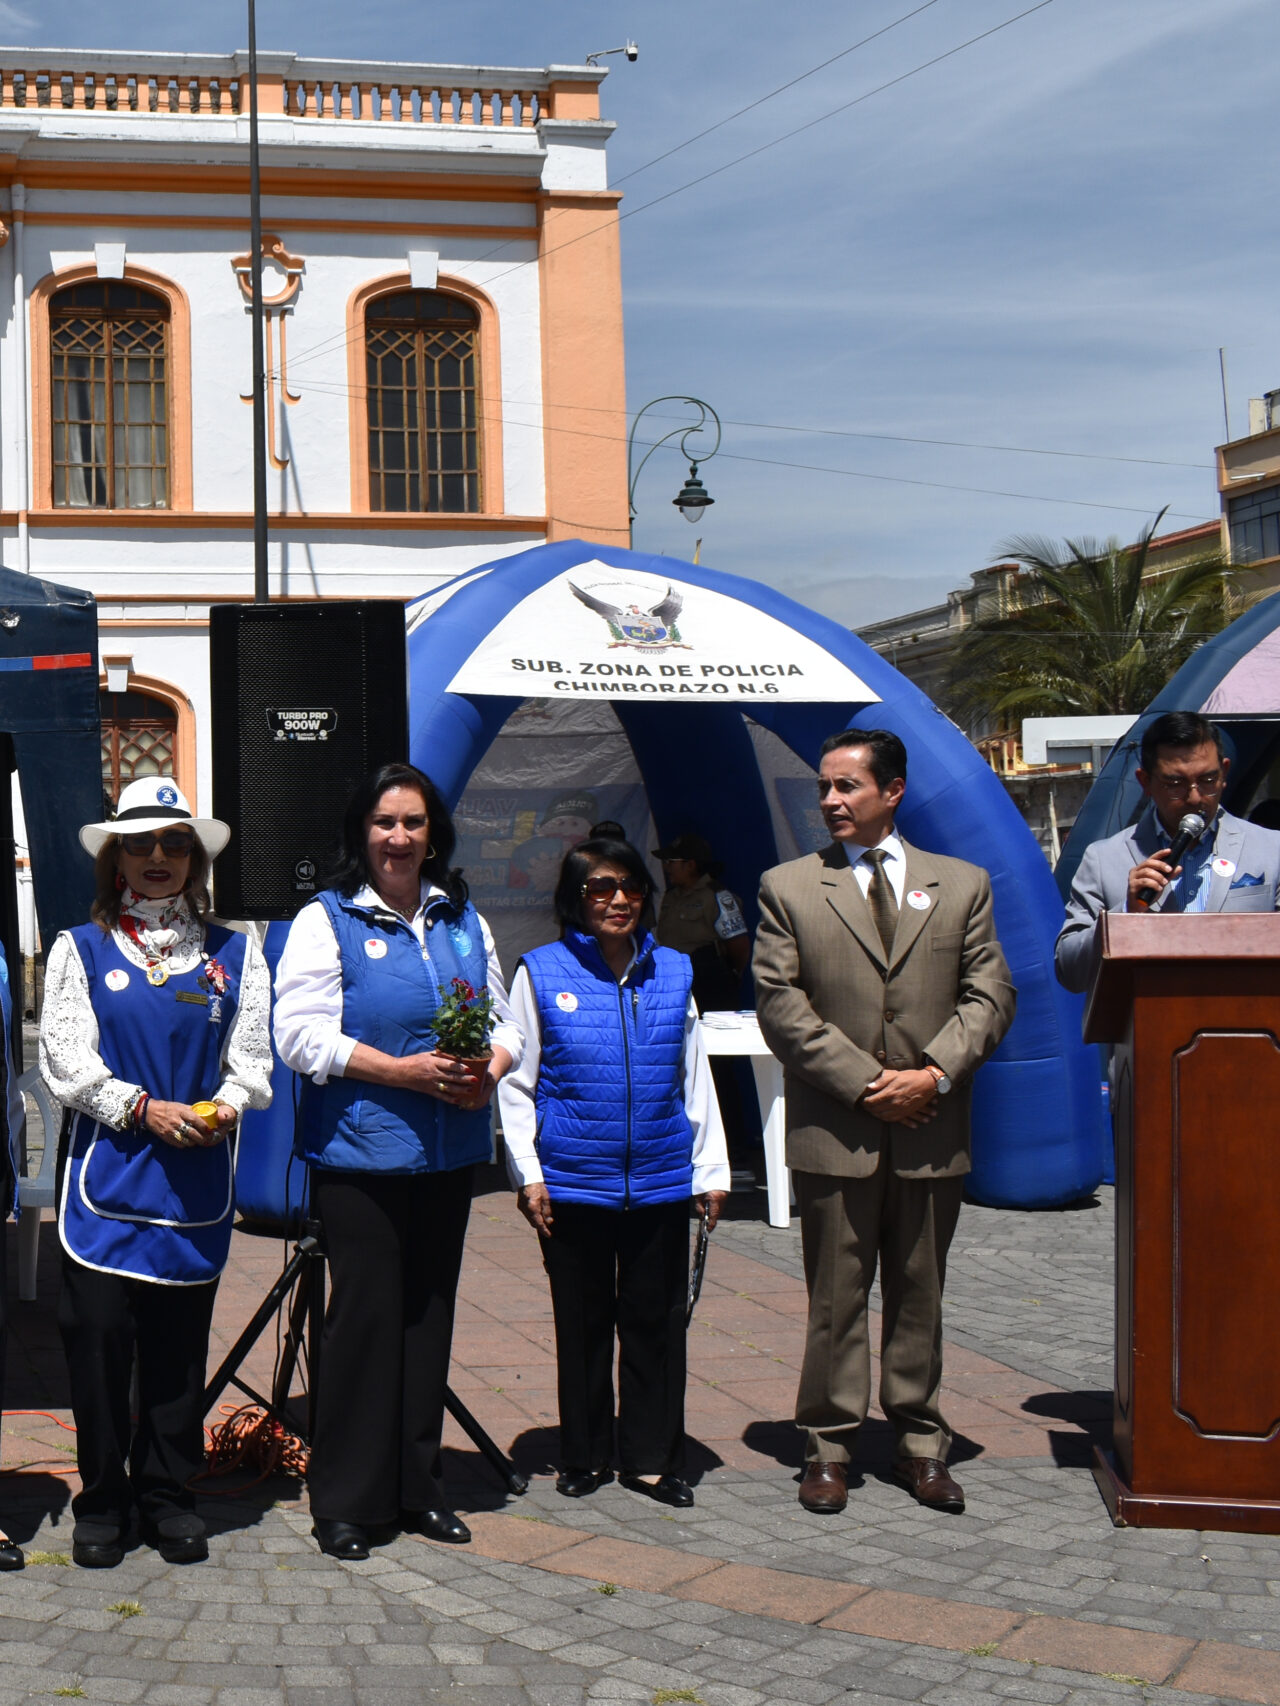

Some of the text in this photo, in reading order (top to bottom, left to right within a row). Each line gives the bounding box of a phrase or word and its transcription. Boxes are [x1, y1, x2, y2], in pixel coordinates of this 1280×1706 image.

[511, 657, 804, 678] SUB. ZONA DE POLICIA
[553, 680, 730, 694] CHIMBORAZO
[277, 711, 329, 720] TURBO PRO
[284, 719, 321, 730] 900W
